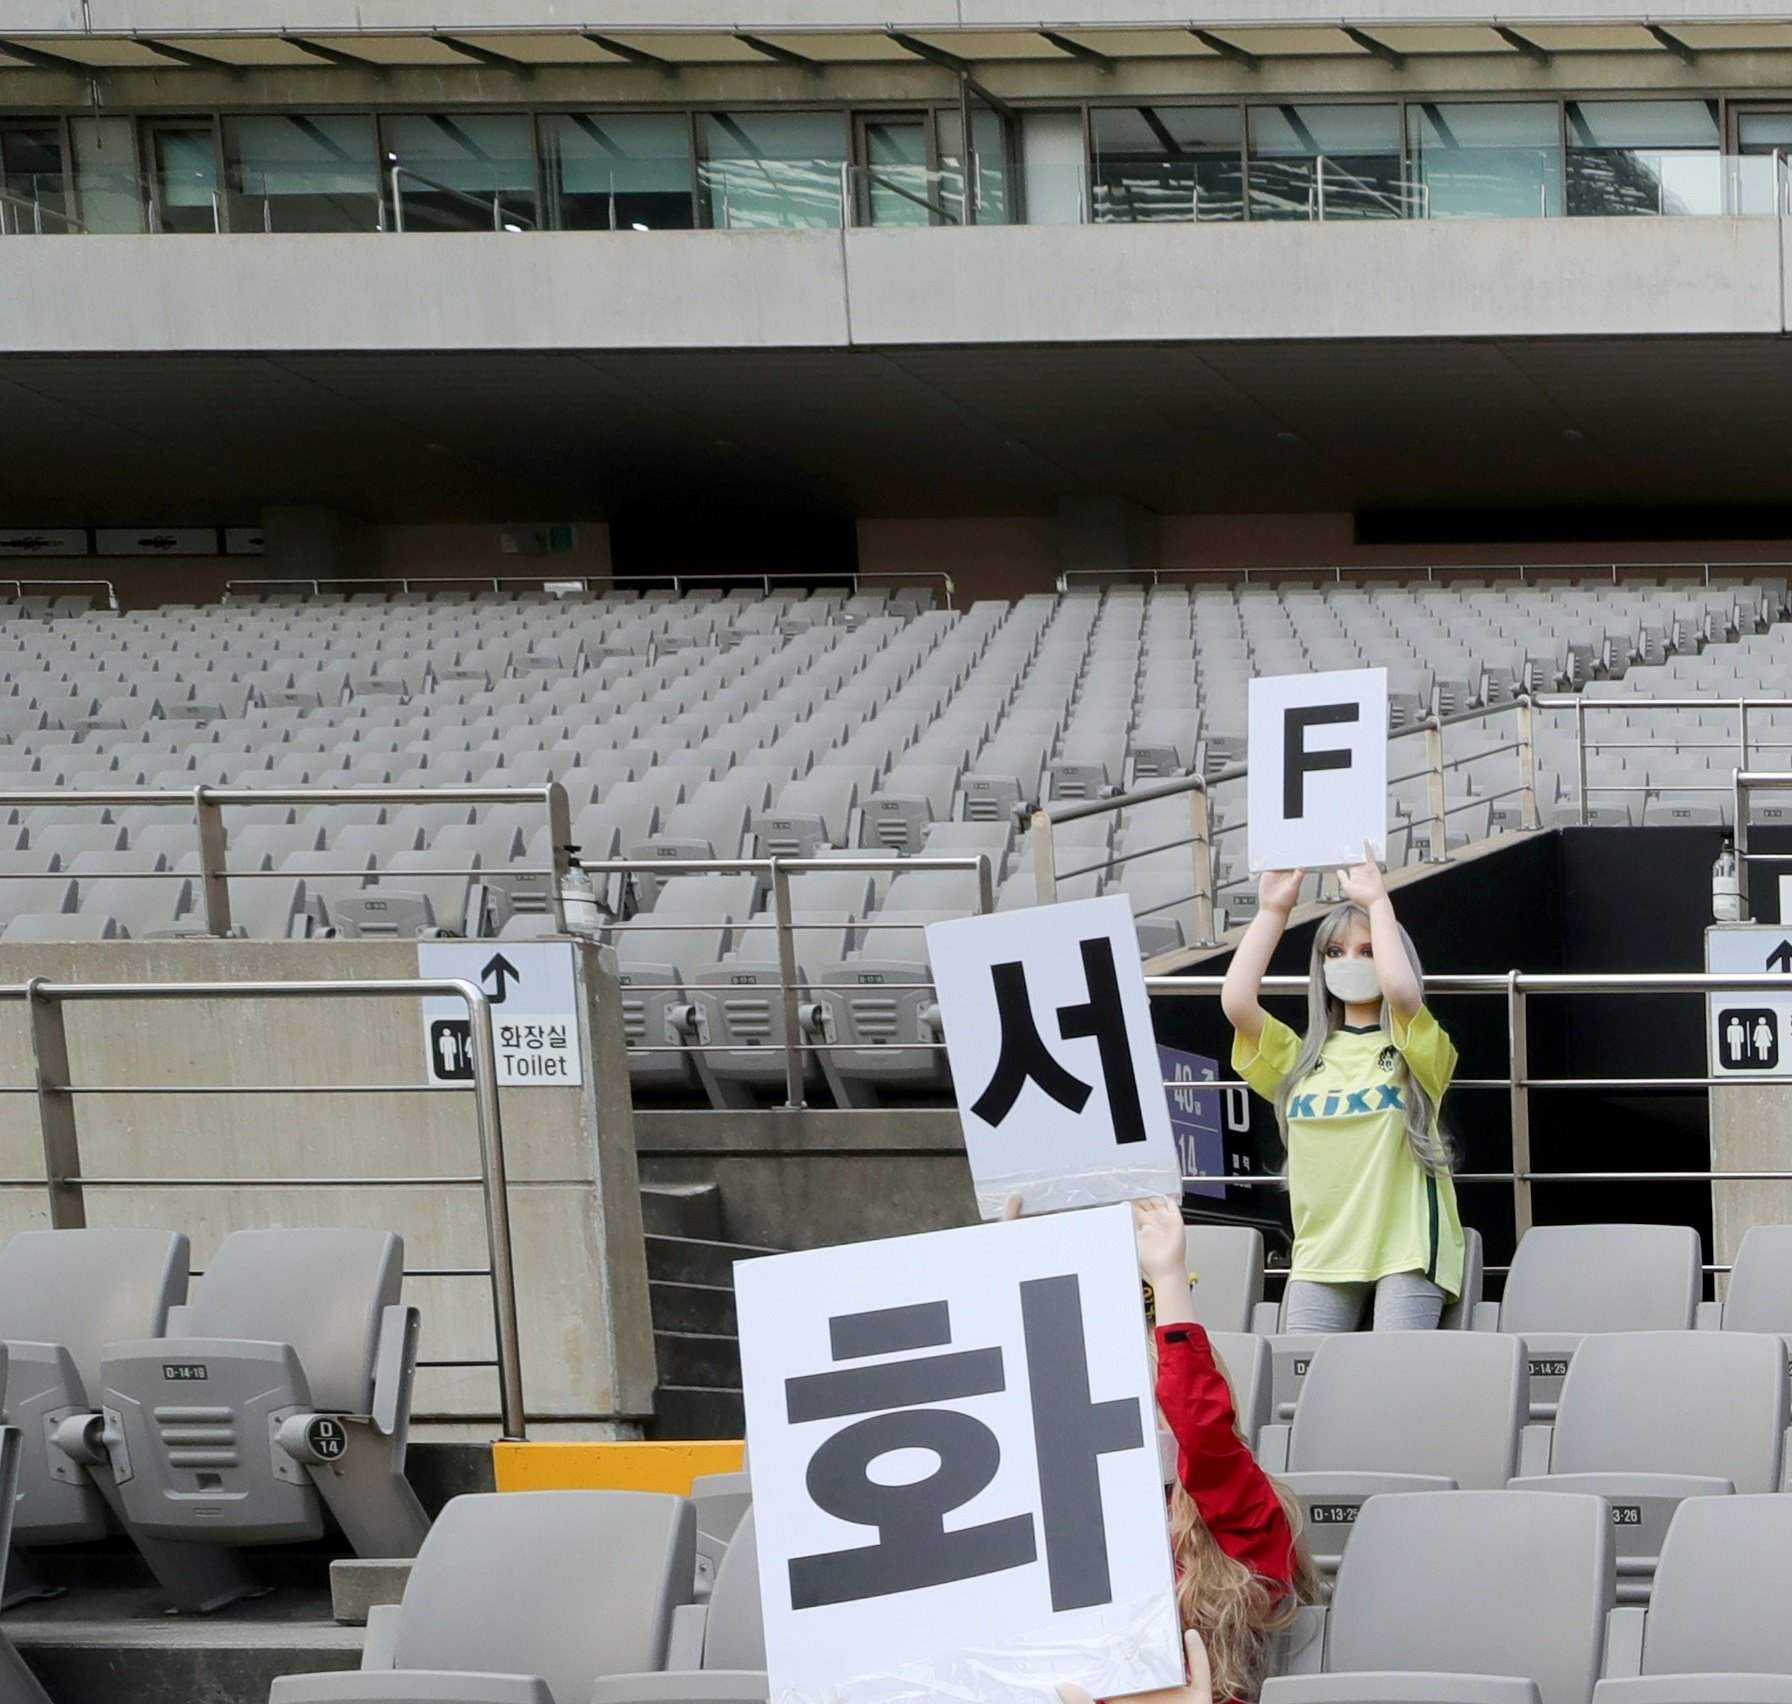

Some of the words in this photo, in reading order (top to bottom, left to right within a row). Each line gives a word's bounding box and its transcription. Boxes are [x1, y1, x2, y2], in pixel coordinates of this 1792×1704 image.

[1284, 703, 1358, 819] F
[500, 1025, 567, 1049] 화장실
[971, 937, 1146, 1144] 서
[504, 1055, 567, 1076] Toilet
[320, 1421, 332, 1436] D
[319, 1439, 339, 1455] 14
[785, 1275, 1144, 1612] 화
